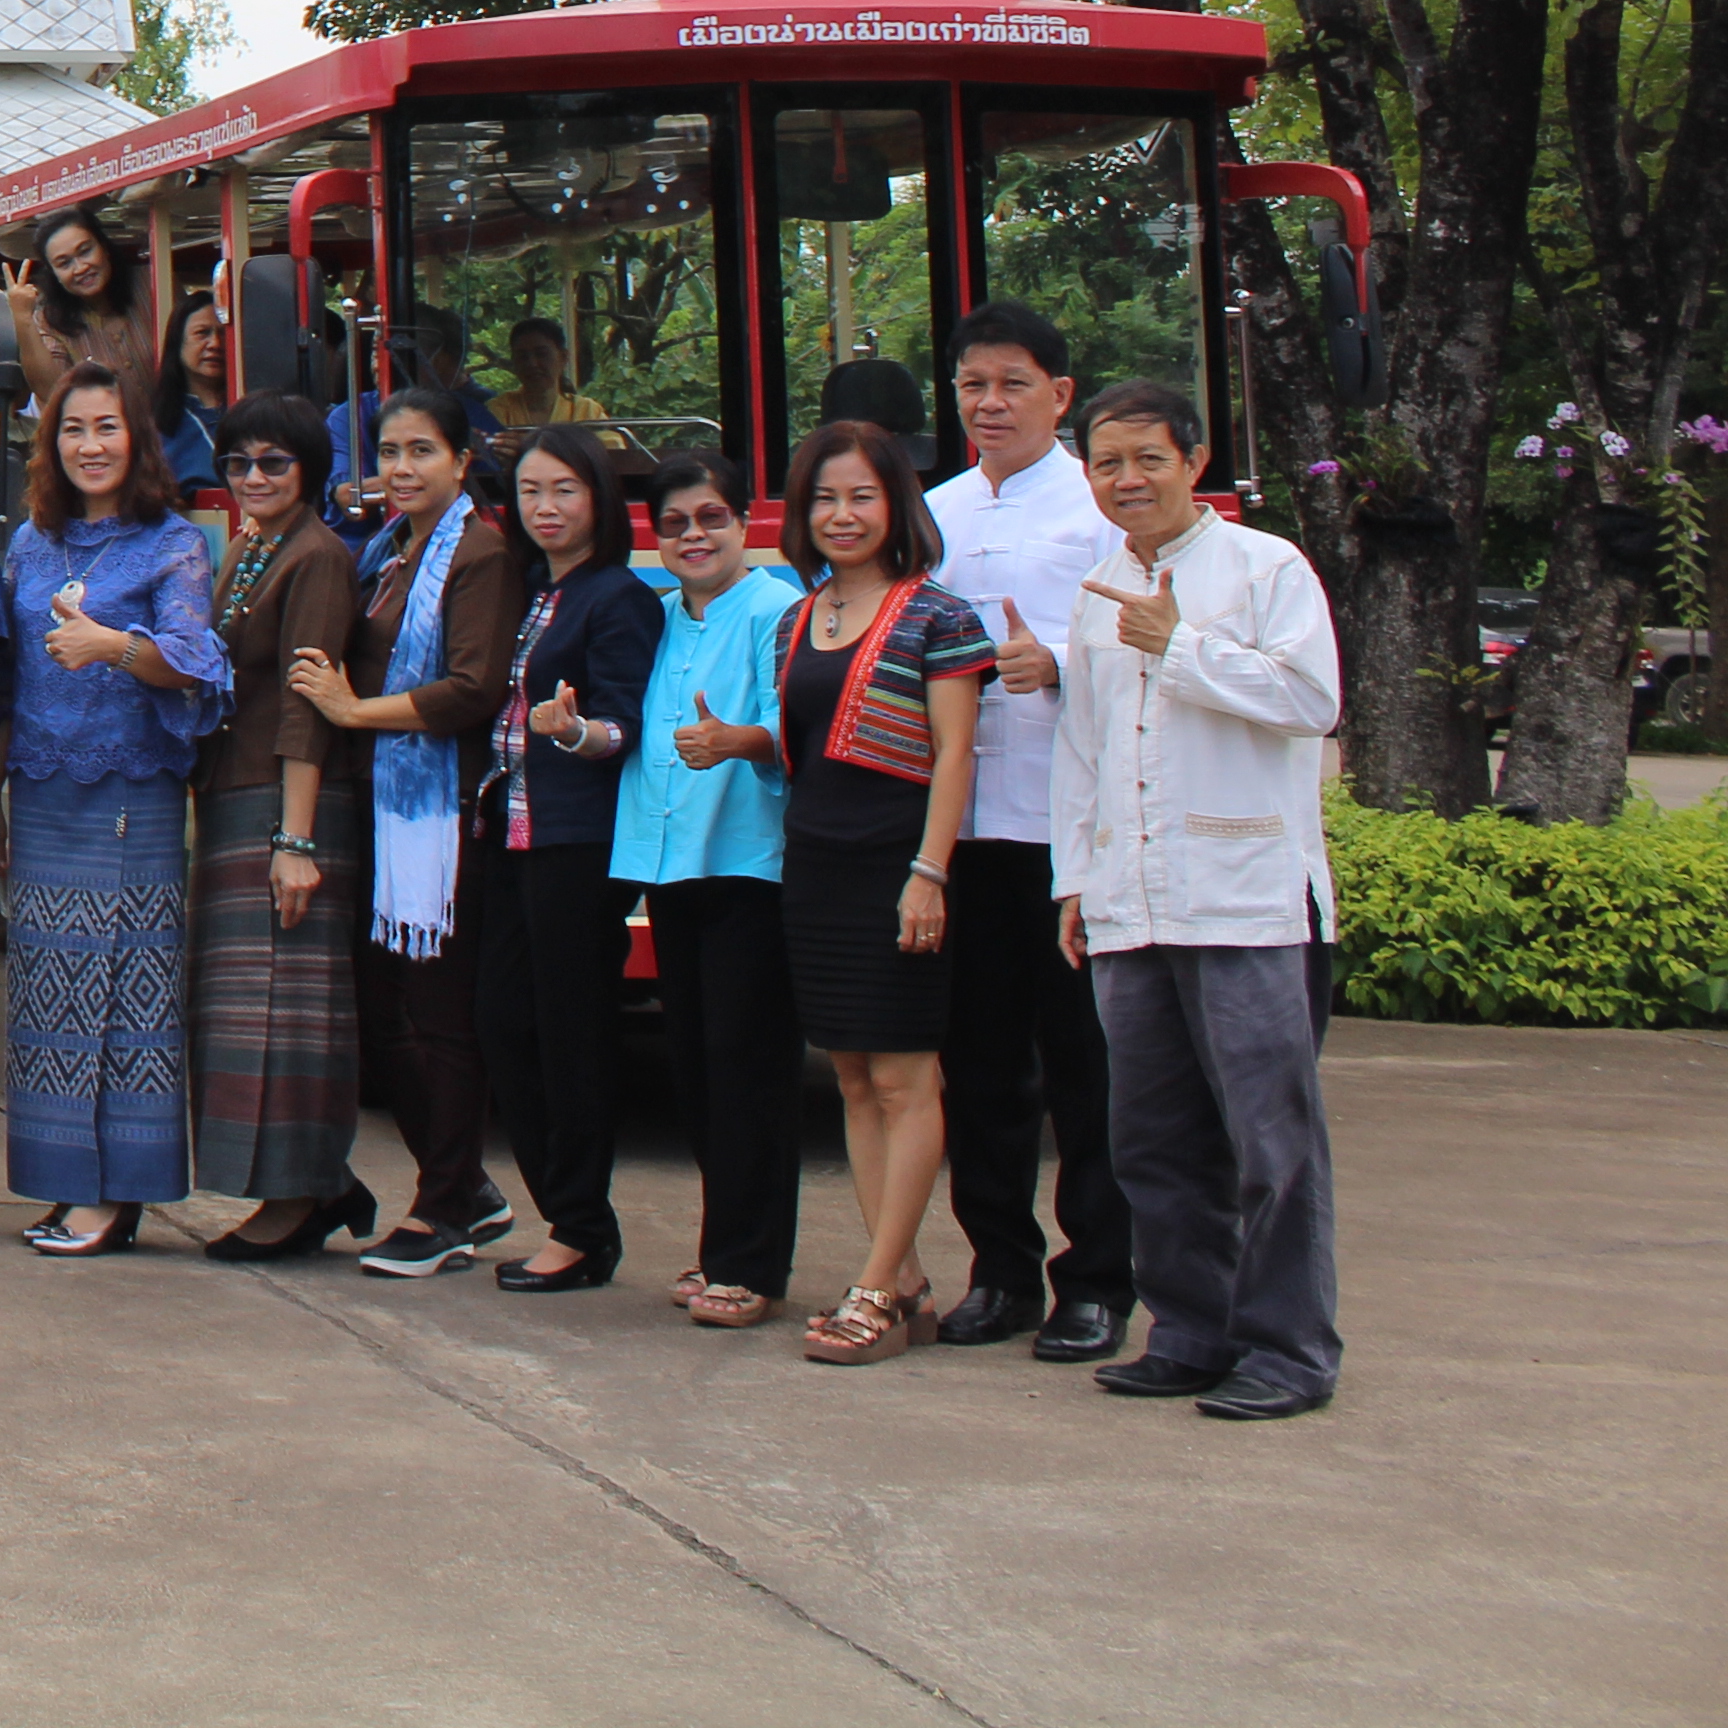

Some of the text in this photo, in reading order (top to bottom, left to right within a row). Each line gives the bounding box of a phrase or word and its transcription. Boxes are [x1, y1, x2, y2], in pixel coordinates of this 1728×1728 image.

[678, 7, 1090, 47] เมืองน่านเมืองเก่าที่มีชีวิต
